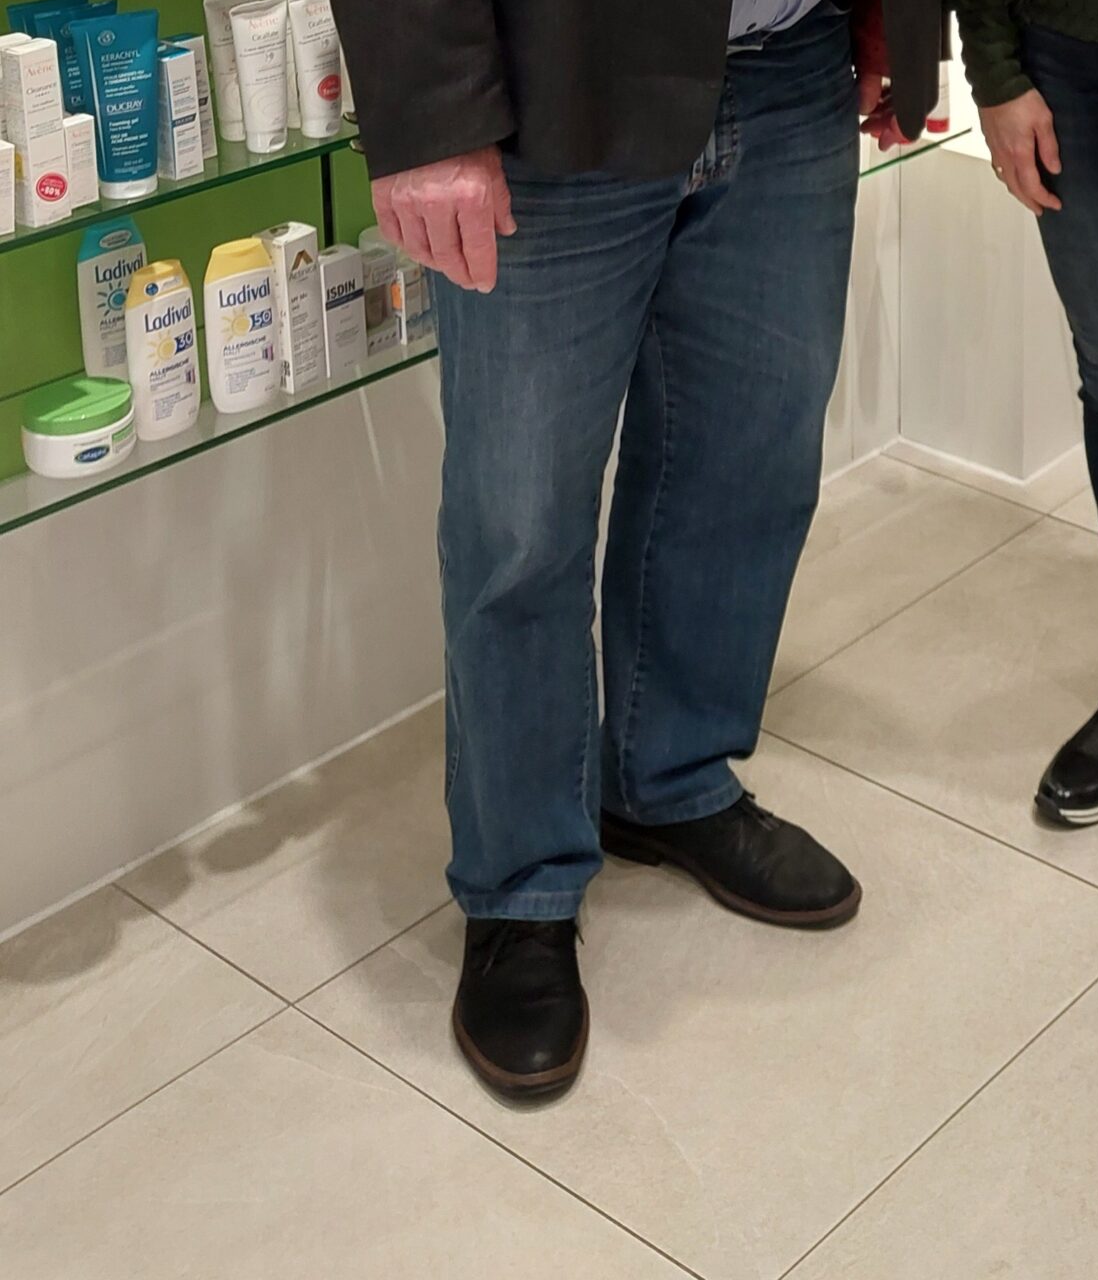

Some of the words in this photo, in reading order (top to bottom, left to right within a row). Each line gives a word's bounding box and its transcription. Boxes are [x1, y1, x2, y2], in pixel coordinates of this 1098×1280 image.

[101, 50, 140, 63] KERACNYL
[106, 100, 143, 113] DUCRAY
[95, 253, 144, 284] Ladival
[219, 276, 271, 308] Ladival
[326, 278, 356, 300] ISDIN
[145, 298, 192, 333] Ladival
[177, 333, 193, 349] 30
